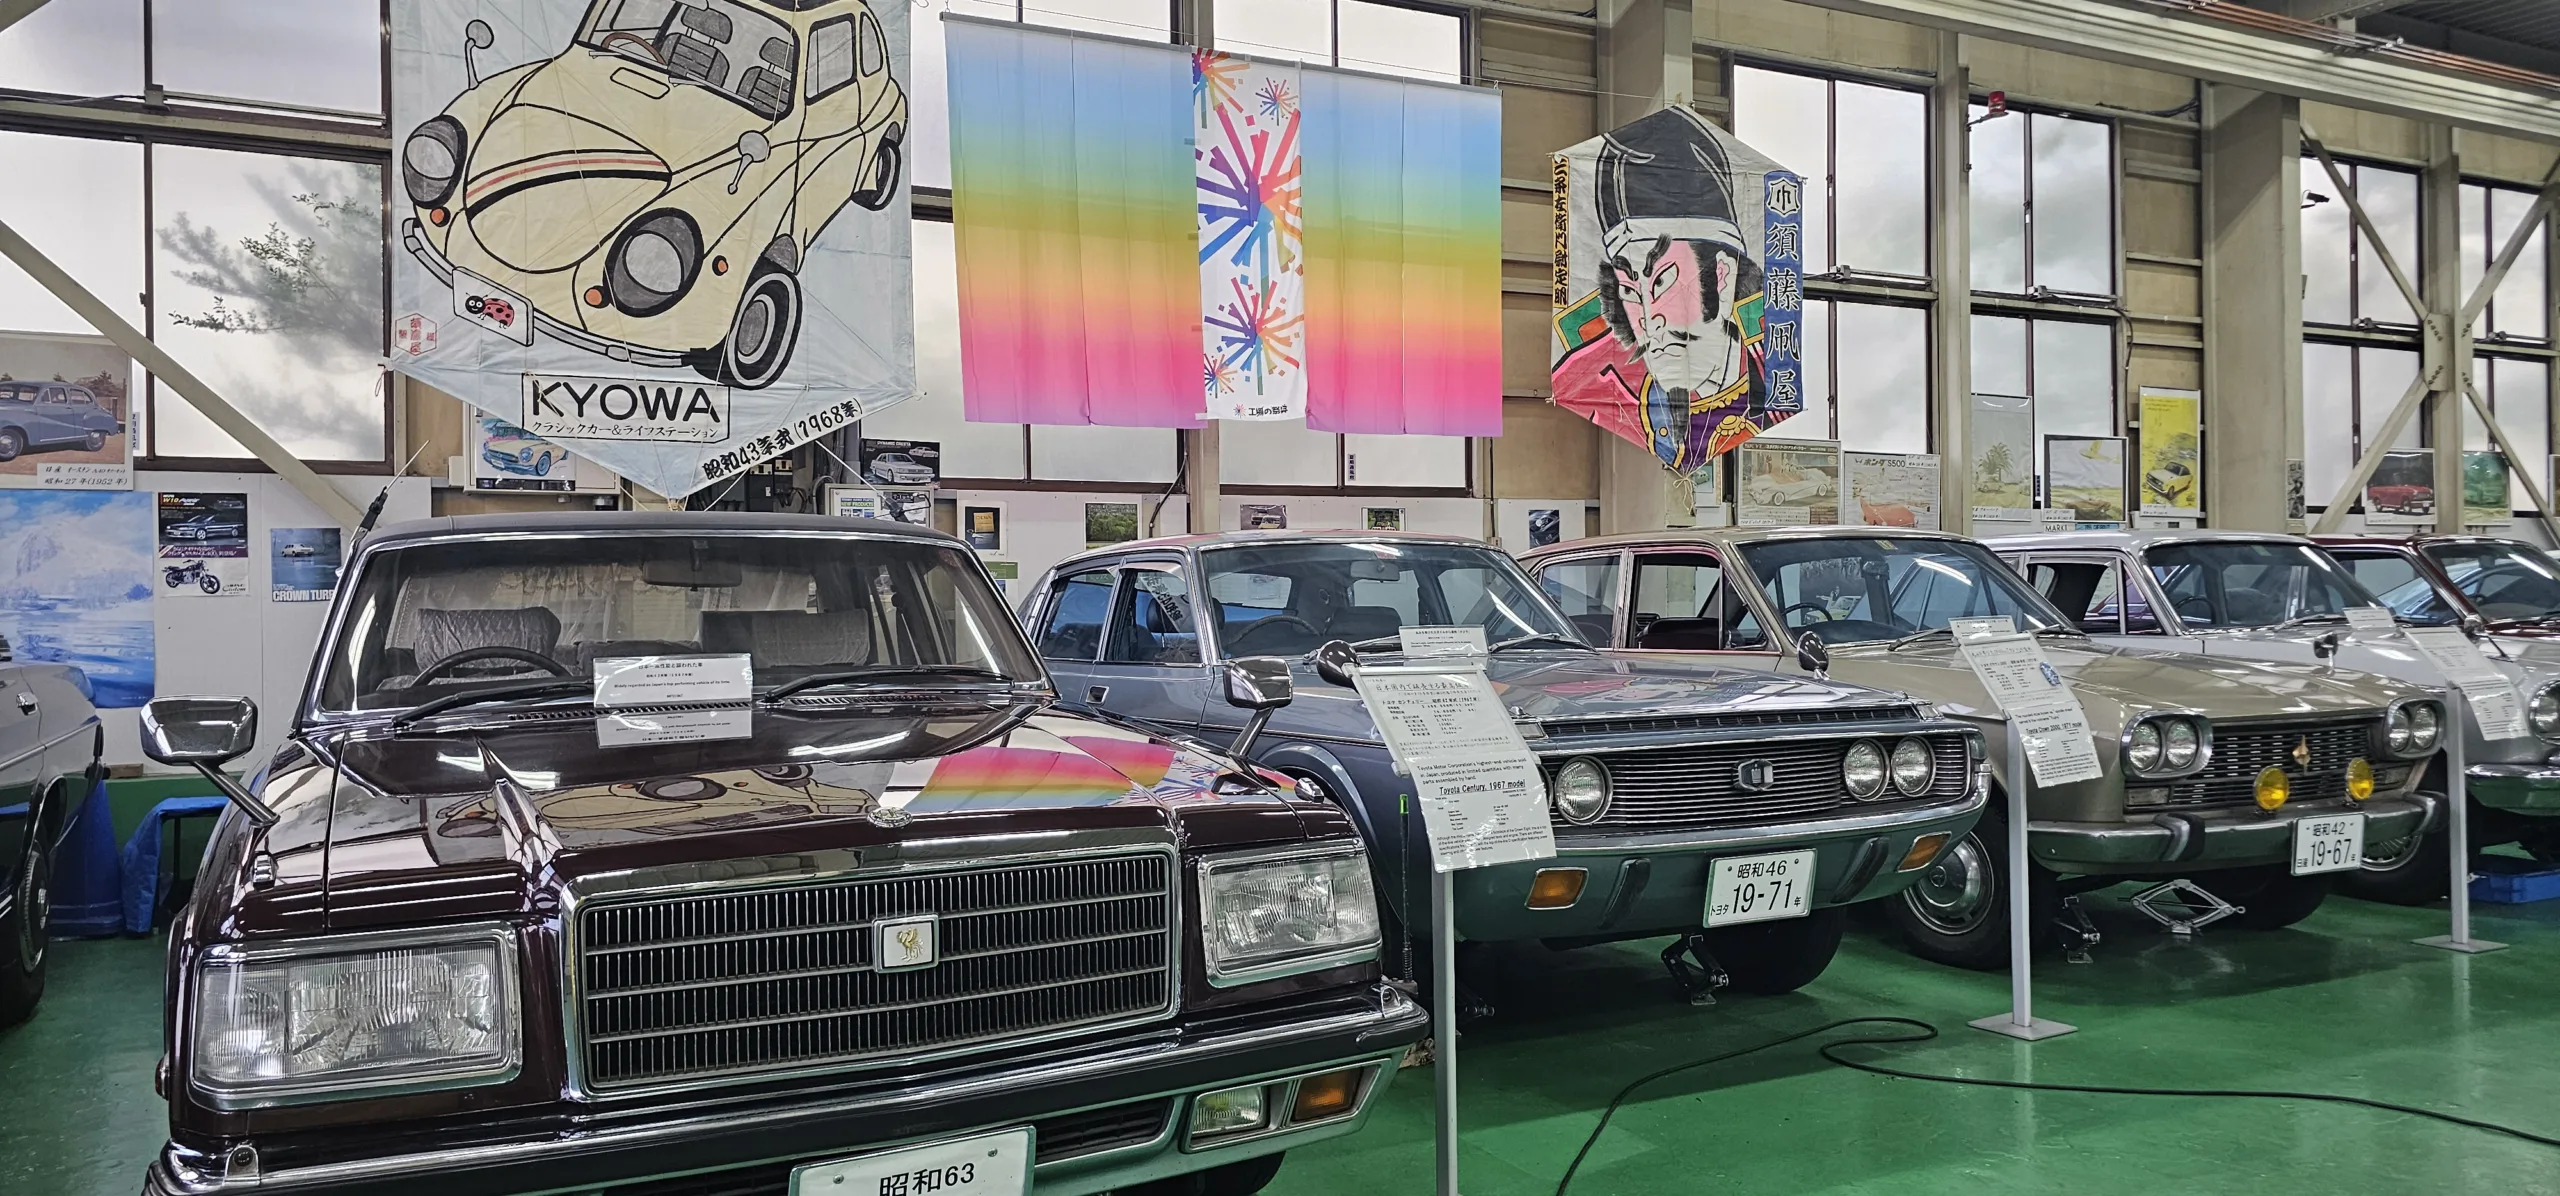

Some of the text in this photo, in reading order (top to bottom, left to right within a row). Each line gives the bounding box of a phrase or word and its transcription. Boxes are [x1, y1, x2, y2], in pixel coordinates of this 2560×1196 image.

[532, 379, 721, 423] KYOWA
[1887, 459, 1906, 468] S500
[272, 590, 309, 602] CROWN
[1439, 786, 1460, 795] Toyota
[1489, 781, 1505, 790] 1967
[1508, 779, 1525, 788] model
[2313, 821, 2345, 836] 昭和42
[2310, 838, 2352, 866] 19-67
[1737, 860, 1787, 879] 昭和46
[1710, 904, 1729, 916] トヨタ
[1733, 878, 1793, 914] 19-71
[879, 1162, 975, 1196] 昭和63
